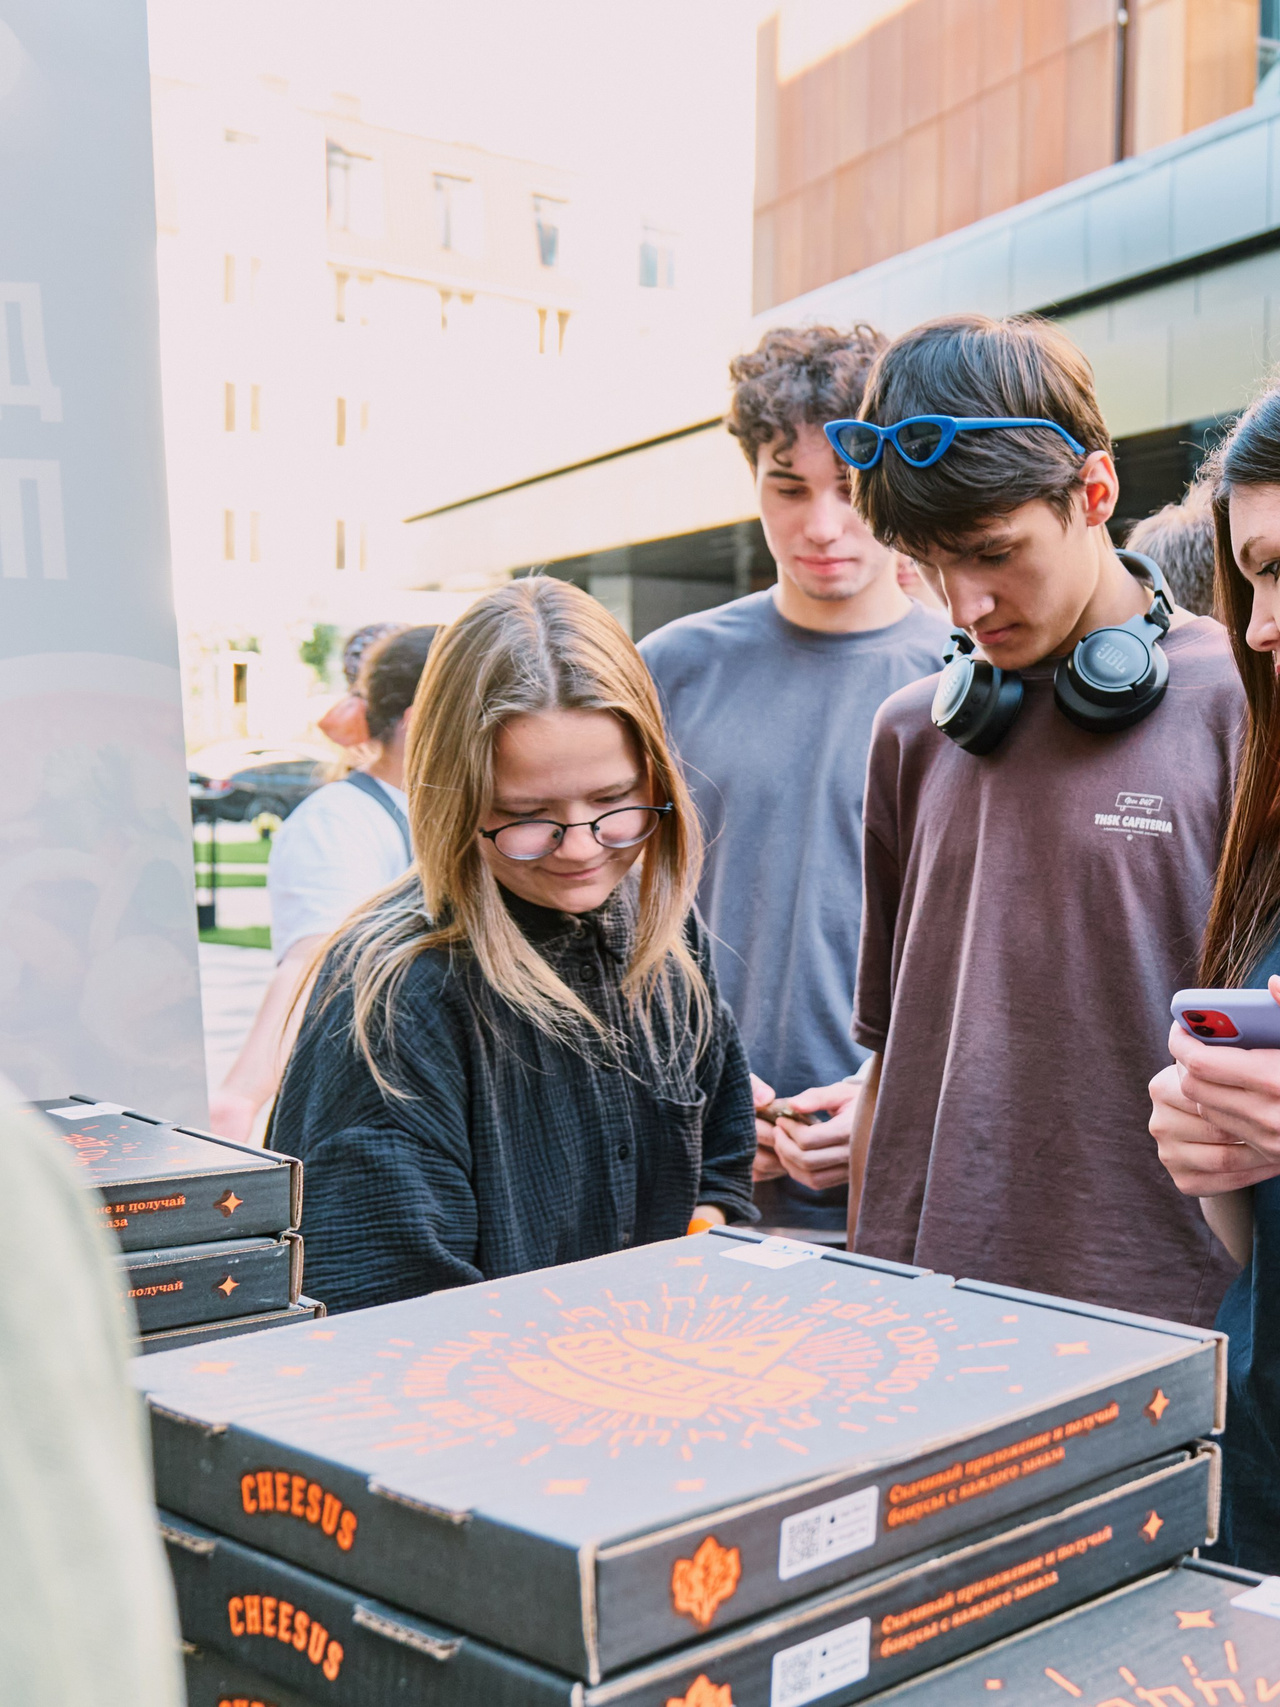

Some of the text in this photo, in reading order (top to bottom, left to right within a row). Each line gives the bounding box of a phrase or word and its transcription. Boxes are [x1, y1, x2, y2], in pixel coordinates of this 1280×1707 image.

[1096, 641, 1127, 674] JBL
[1121, 815, 1173, 834] CAFETERIA
[128, 1195, 187, 1212] получай
[127, 1280, 185, 1299] получай
[241, 1470, 358, 1551] CHEESUS
[228, 1594, 344, 1682] CHEESUS
